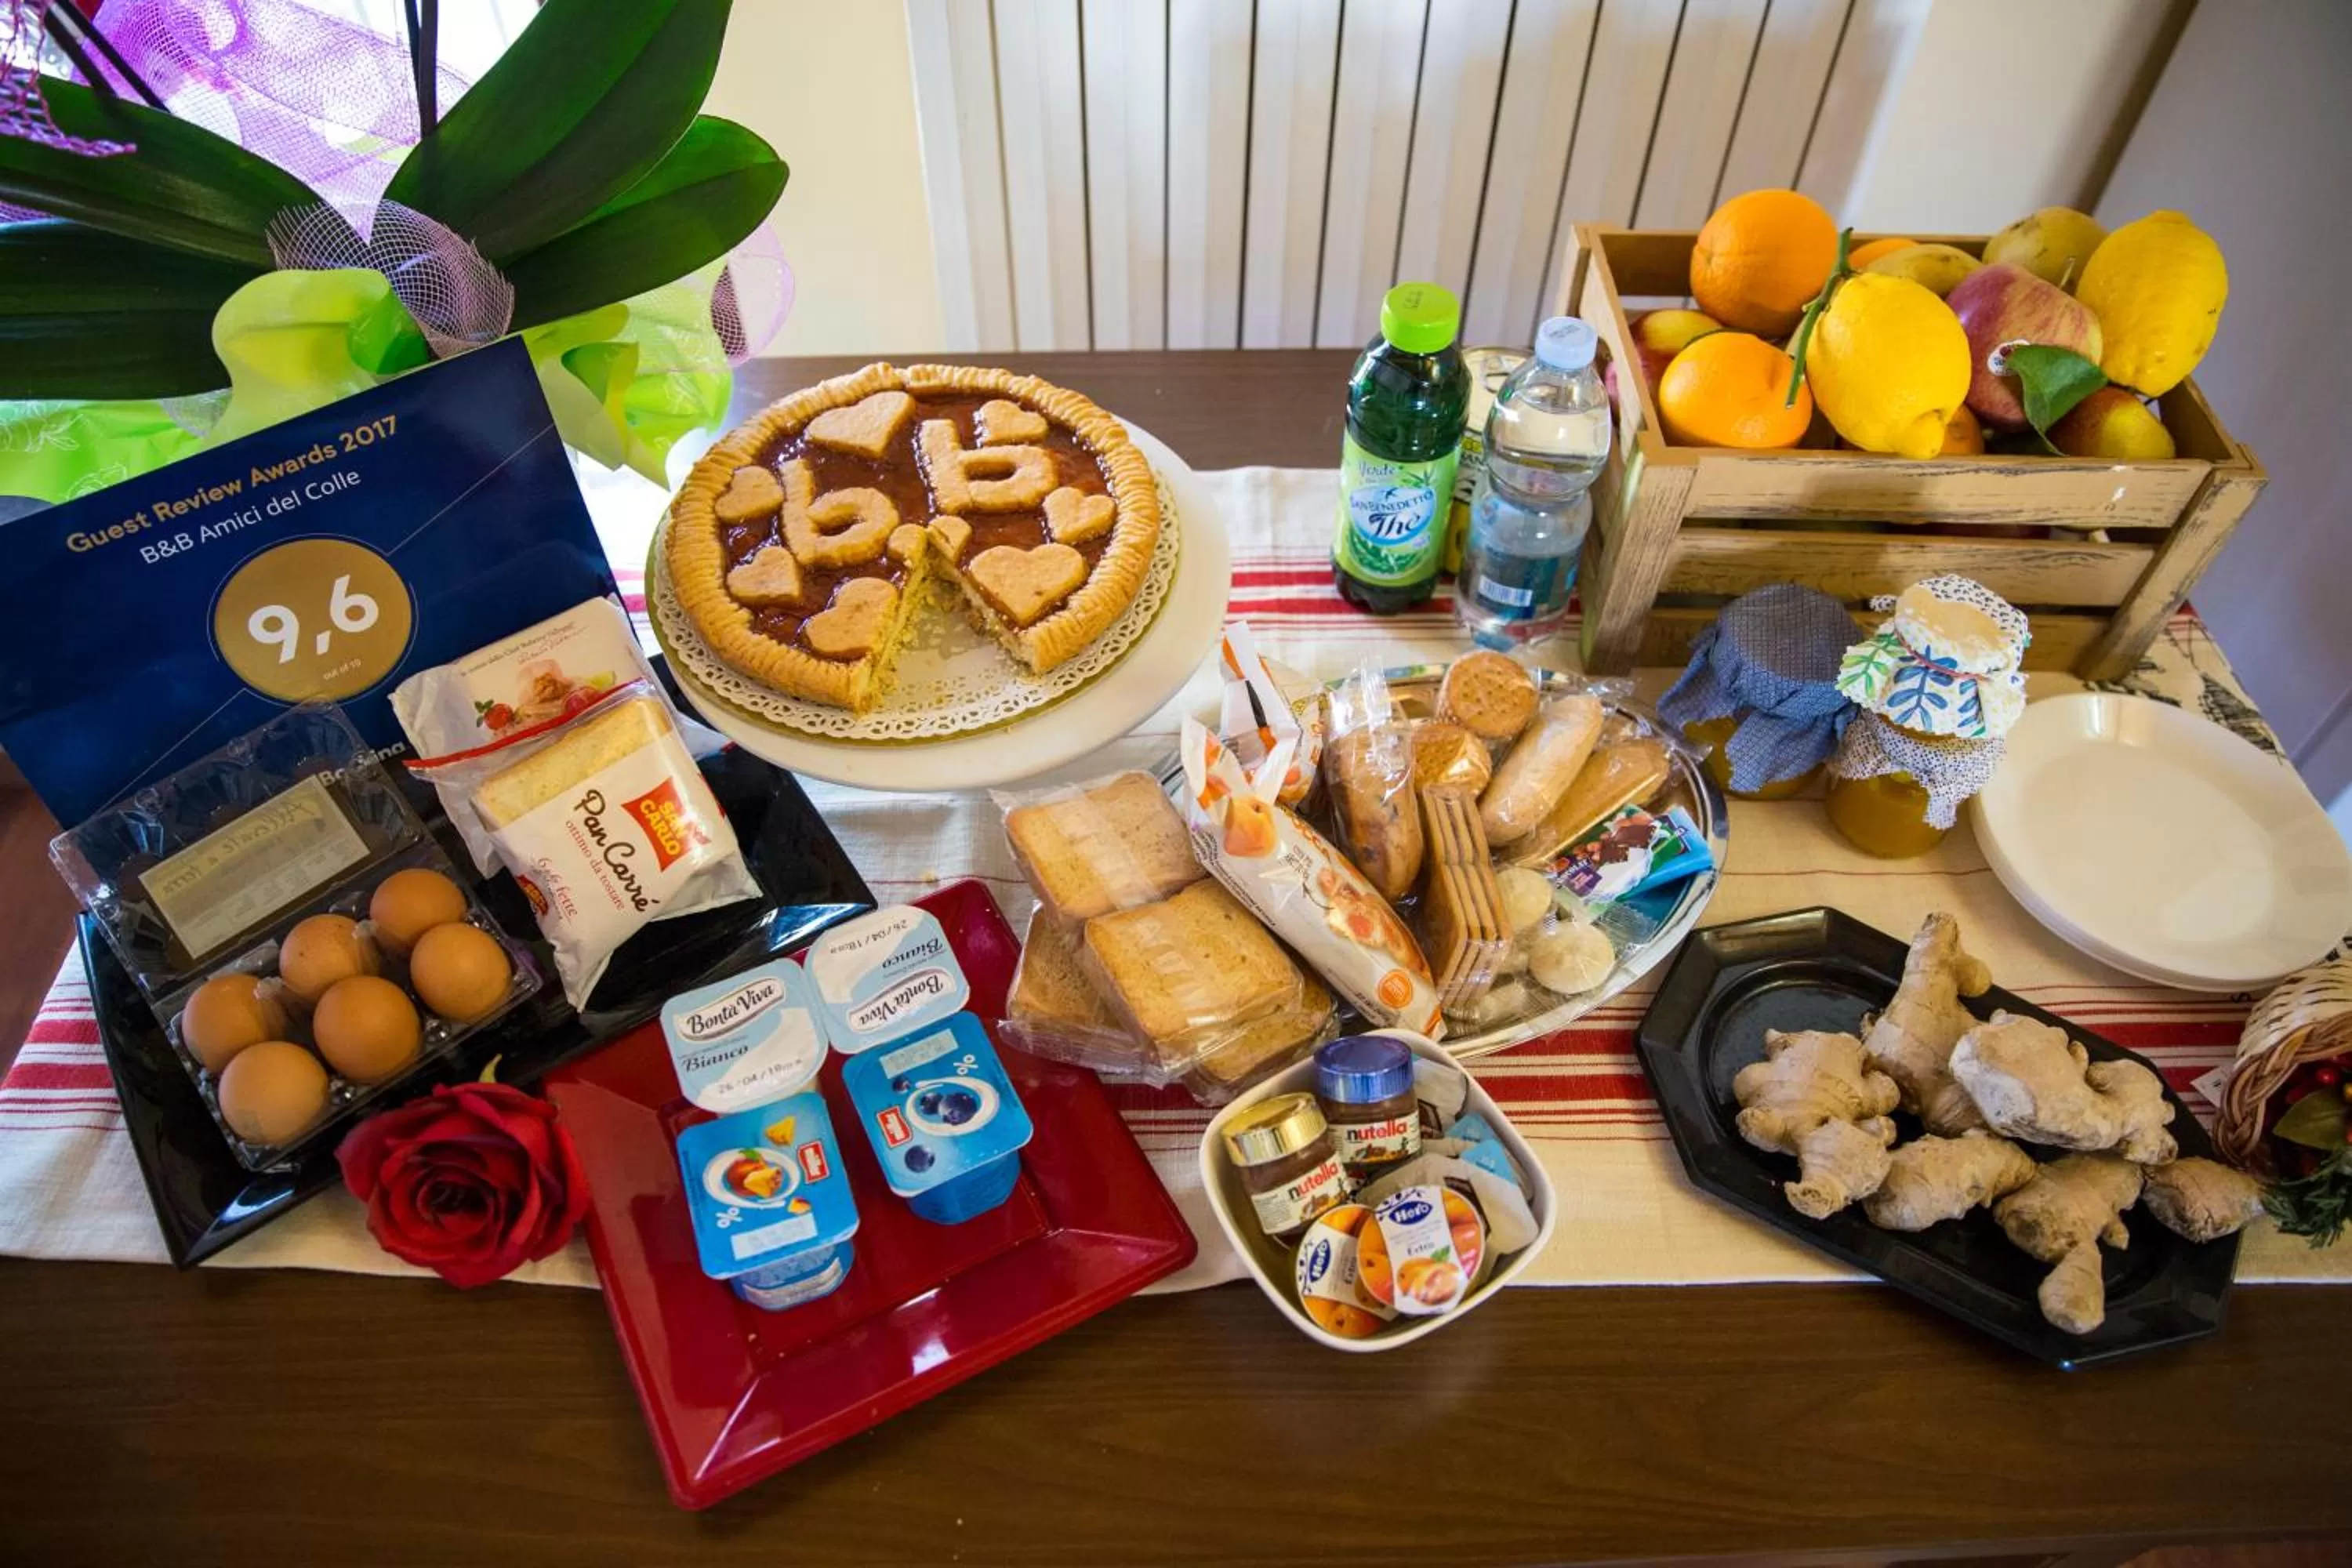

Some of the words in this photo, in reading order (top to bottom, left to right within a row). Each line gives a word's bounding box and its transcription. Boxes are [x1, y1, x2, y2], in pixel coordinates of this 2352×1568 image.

[66, 510, 152, 553] Guest
[152, 475, 242, 523] Review
[249, 444, 337, 488] Awards
[338, 414, 398, 453] 2017
[140, 532, 194, 564] B&B
[199, 505, 262, 544] Amici
[266, 490, 301, 517] del
[304, 470, 361, 502] Colle
[247, 574, 379, 665] 9,6
[639, 800, 682, 857] CARLO
[658, 800, 689, 838] SAN
[566, 819, 593, 859] ottimo
[590, 858, 603, 874] da
[599, 872, 626, 911] tostare
[573, 789, 608, 848] Pan
[603, 841, 660, 913] Carré
[882, 938, 944, 970] Bianco
[688, 1000, 739, 1036] Bontà
[735, 982, 776, 1012] Viva
[859, 997, 901, 1026] Viva
[895, 975, 944, 1007] Bontà
[681, 1044, 749, 1073] Bianco
[1347, 1119, 1408, 1142] nutella
[1287, 1161, 1340, 1201] nutella
[1393, 1200, 1430, 1225] Hero
[1309, 1240, 1330, 1282] Hero
